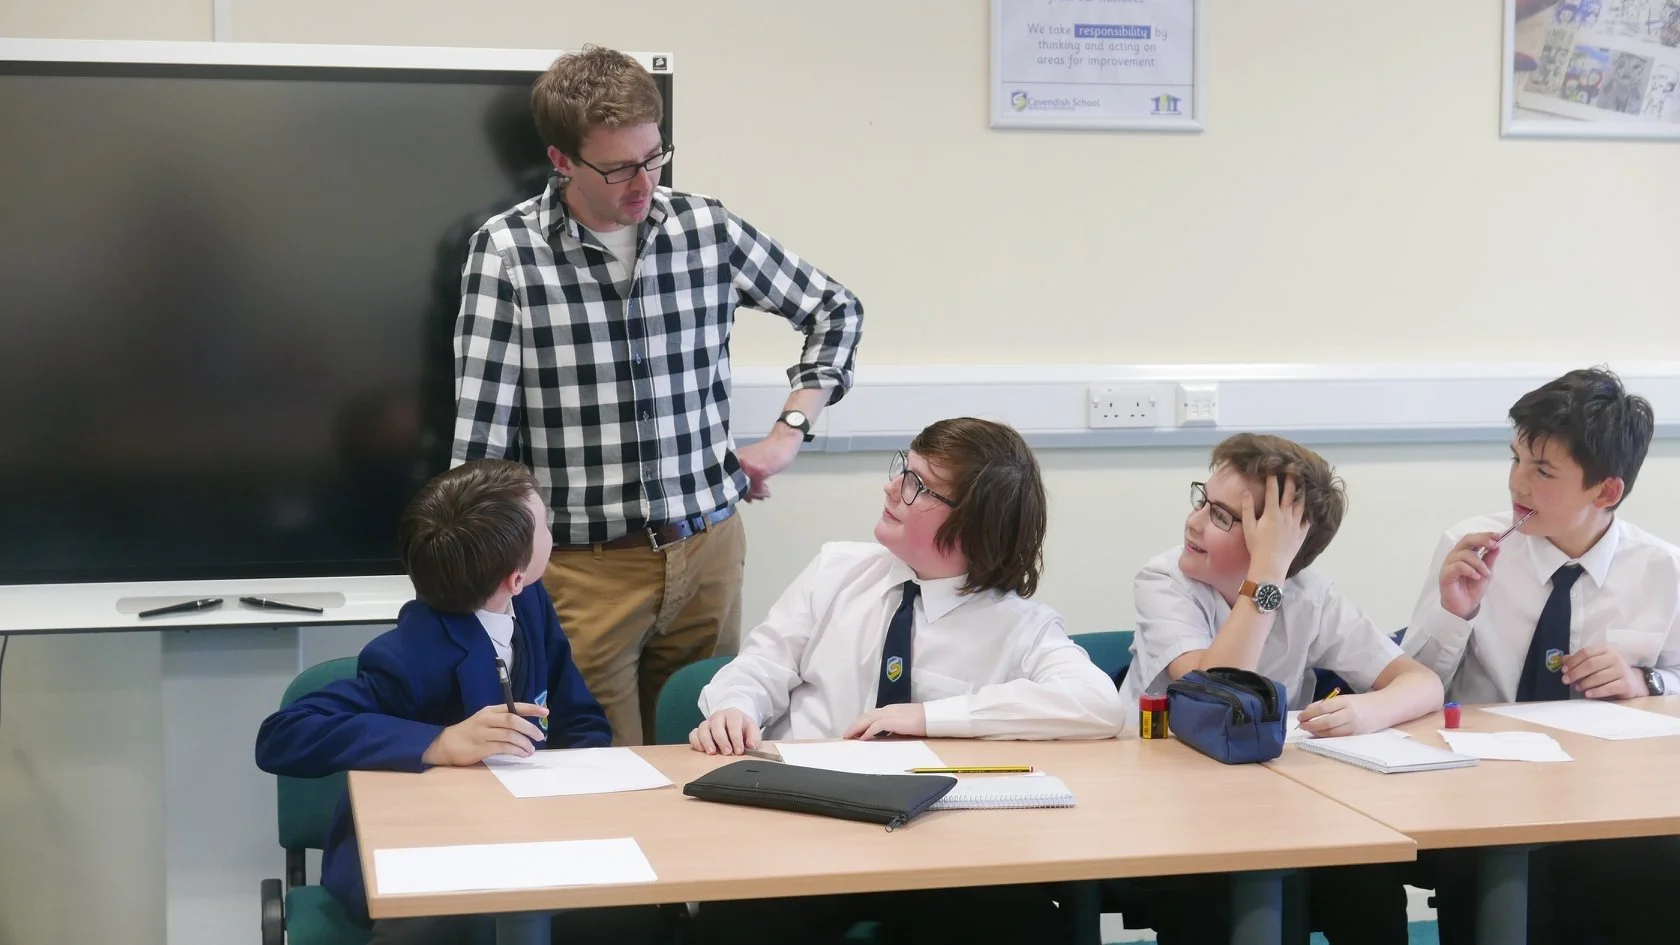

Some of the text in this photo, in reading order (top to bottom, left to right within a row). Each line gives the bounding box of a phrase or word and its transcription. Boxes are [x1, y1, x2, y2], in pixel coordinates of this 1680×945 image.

[1027, 23, 1168, 40] We take responsibility by
[1038, 39, 1157, 55] thinking and acting on
[1036, 56, 1065, 65] areas
[1068, 54, 1083, 69] for
[1028, 96, 1070, 106] Cavendish
[1072, 97, 1101, 108] School
